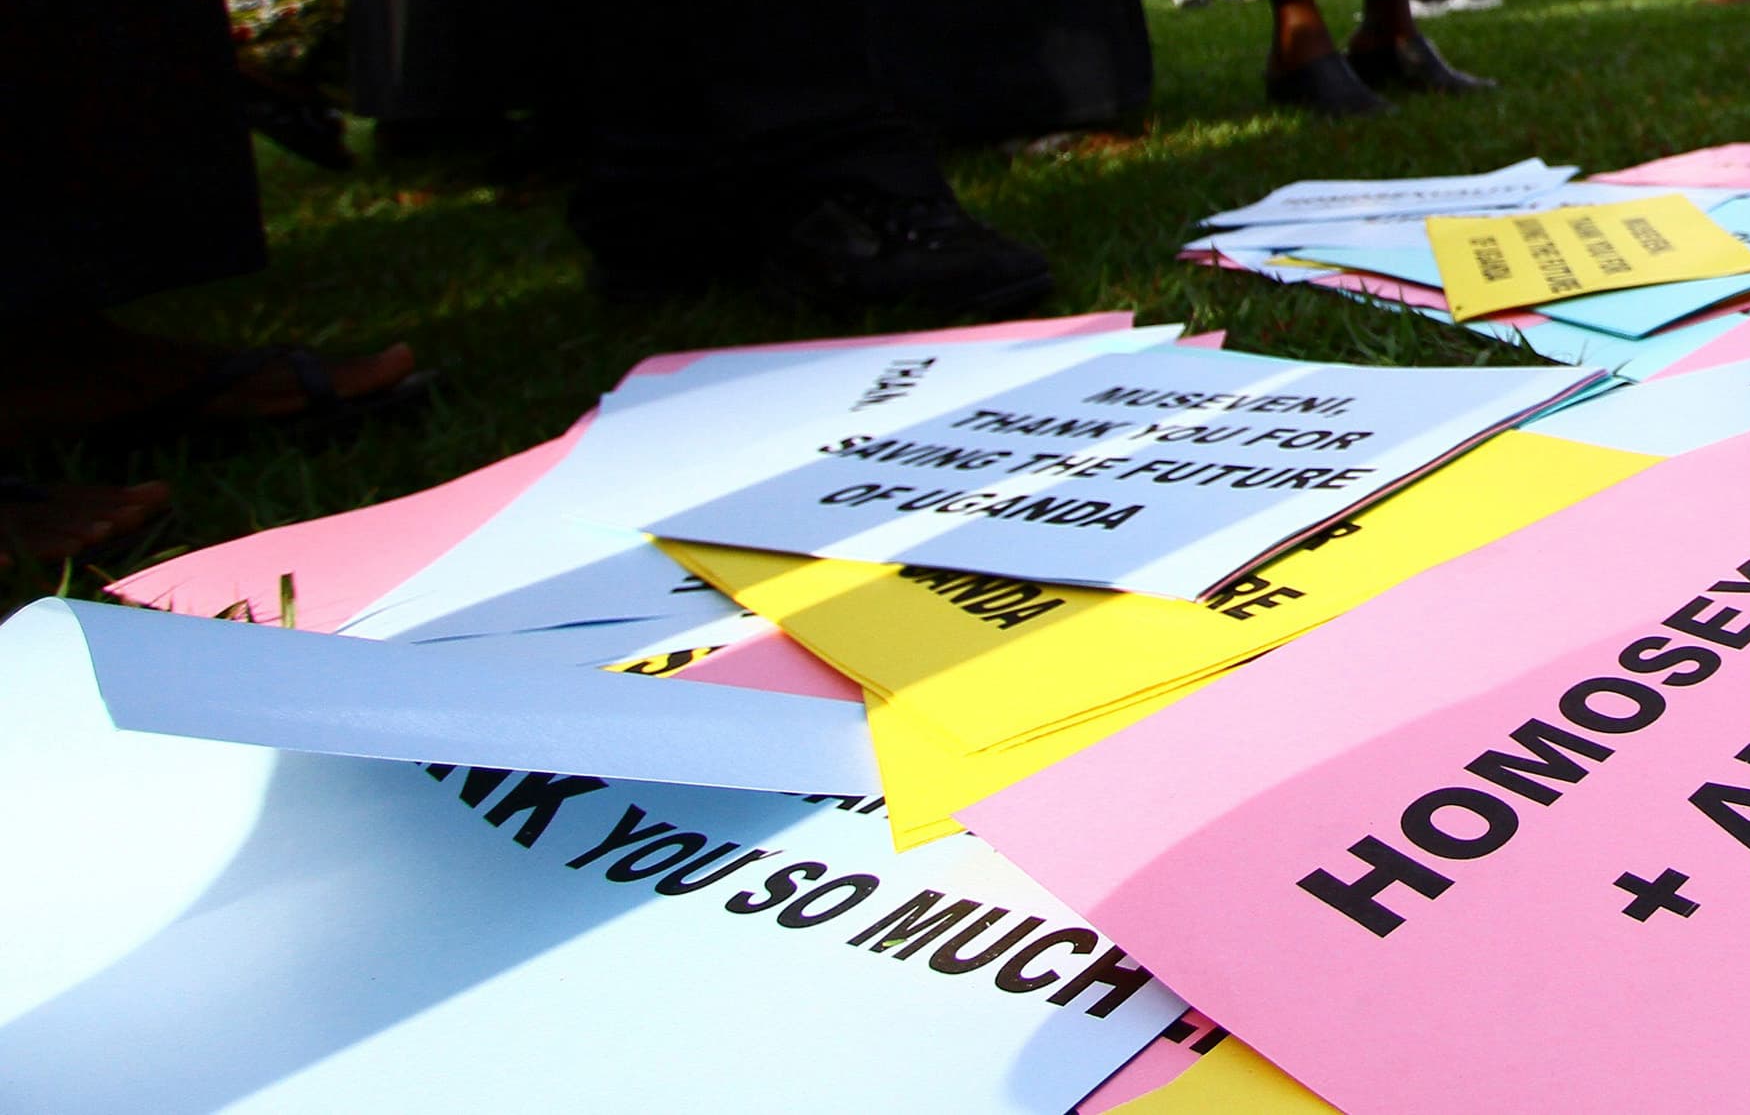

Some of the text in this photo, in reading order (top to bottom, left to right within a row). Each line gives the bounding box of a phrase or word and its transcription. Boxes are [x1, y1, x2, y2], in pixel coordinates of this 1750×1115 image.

[1081, 386, 1356, 417] MUSEVENI,
[952, 410, 1374, 450] THANK YOU FOR
[818, 435, 1378, 489] SAVING THE FUTURE
[820, 484, 1146, 529] OF UGANDA
[565, 802, 765, 897] YOU
[724, 861, 881, 929] SO
[846, 889, 1156, 1019] MUCH
